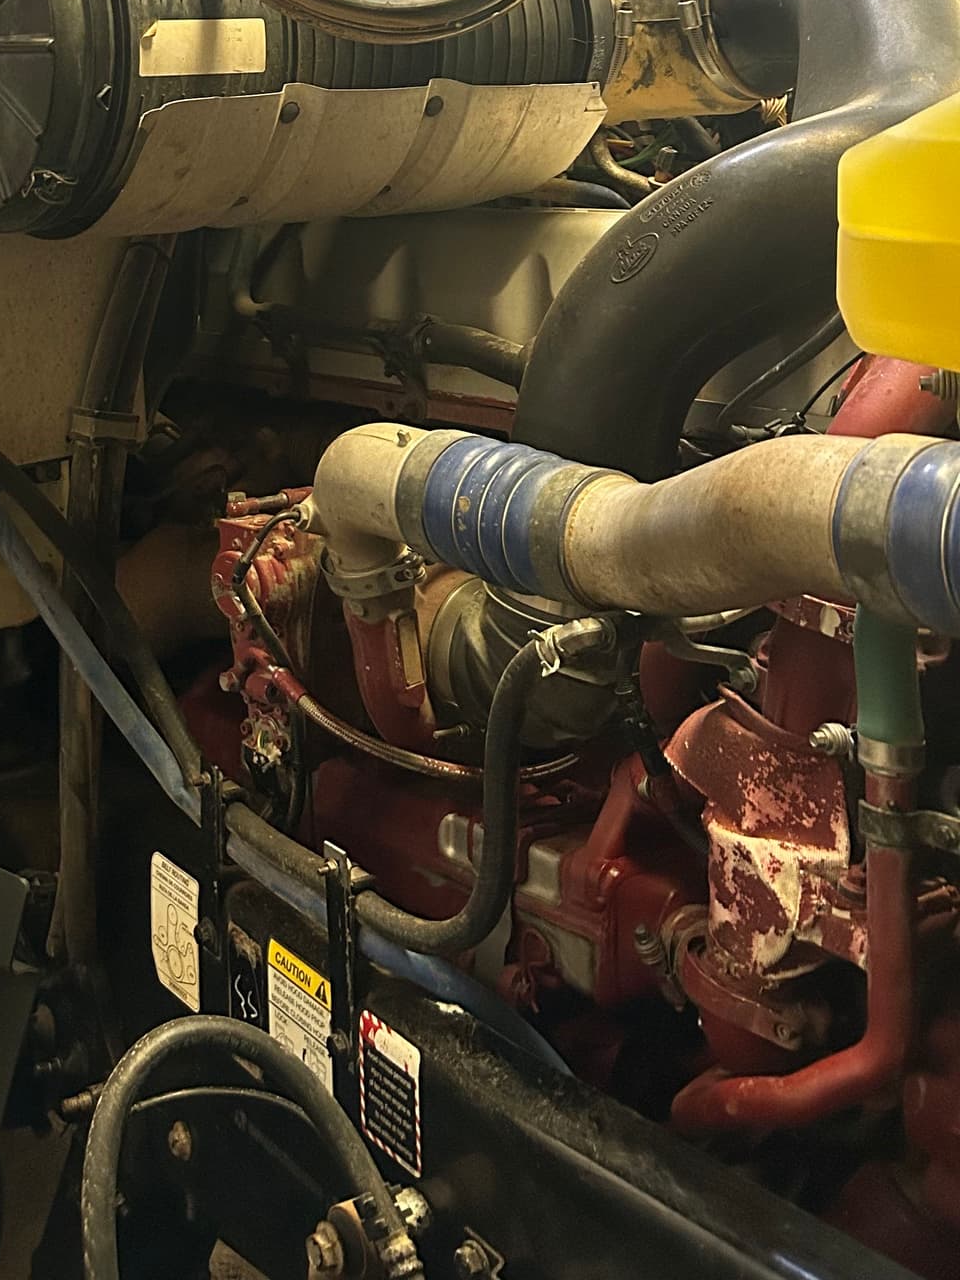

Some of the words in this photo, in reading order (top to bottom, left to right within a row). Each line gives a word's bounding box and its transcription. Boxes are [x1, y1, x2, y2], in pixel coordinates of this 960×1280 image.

[662, 198, 697, 229] CANADA
[275, 951, 311, 988] CAUTION
[274, 983, 296, 1006] RELEASE
[296, 1000, 311, 1018] HOOD
[288, 983, 303, 1001] HOOD
[274, 1008, 288, 1026] LOCK
[303, 1033, 326, 1058] RELEASE
